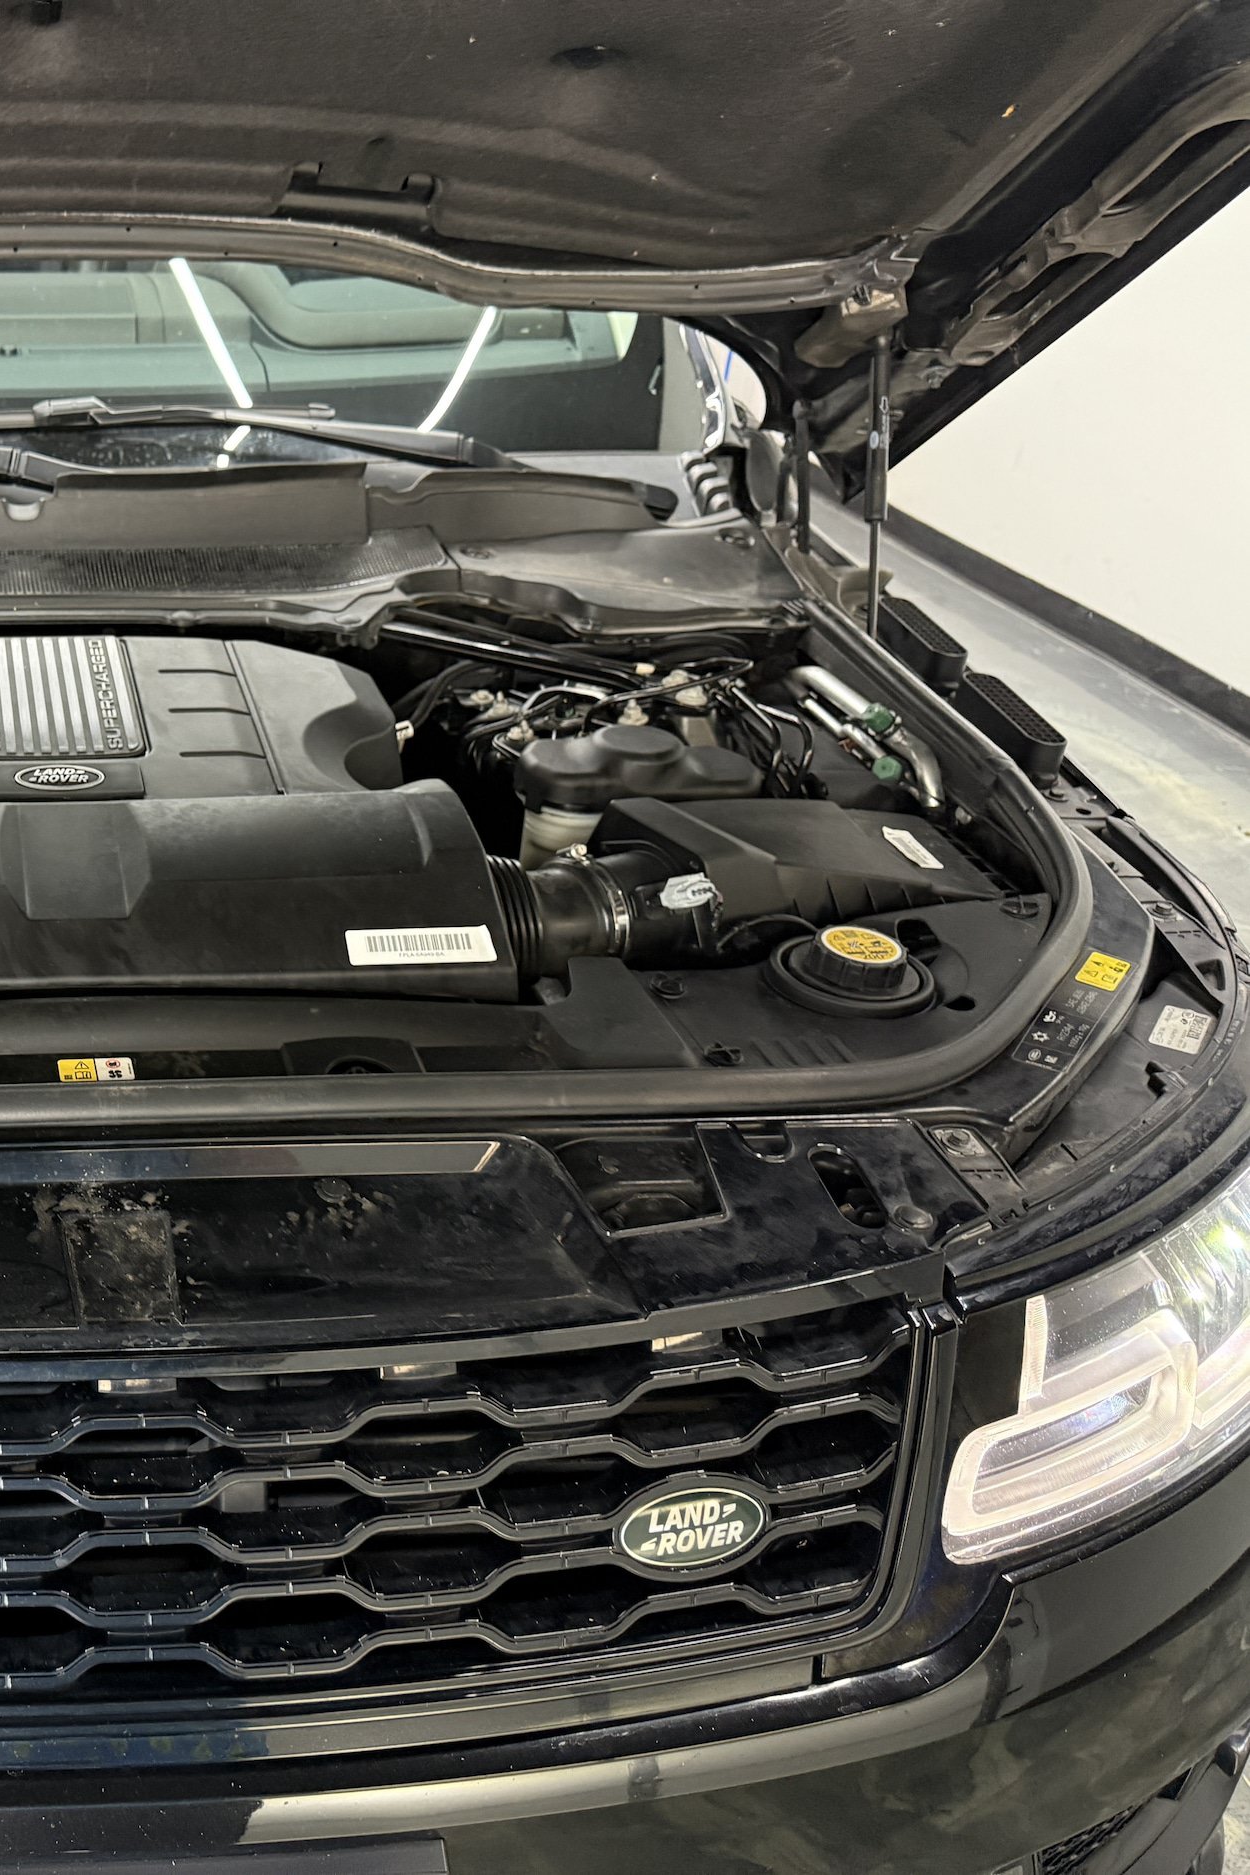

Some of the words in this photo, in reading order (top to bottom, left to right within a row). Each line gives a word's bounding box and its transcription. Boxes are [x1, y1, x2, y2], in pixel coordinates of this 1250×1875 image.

[88, 639, 124, 750] SUPERCHARGED
[33, 768, 76, 776] LAND
[38, 774, 89, 783] ROVER
[649, 1500, 720, 1533] LAND
[657, 1520, 744, 1556] ROVER
